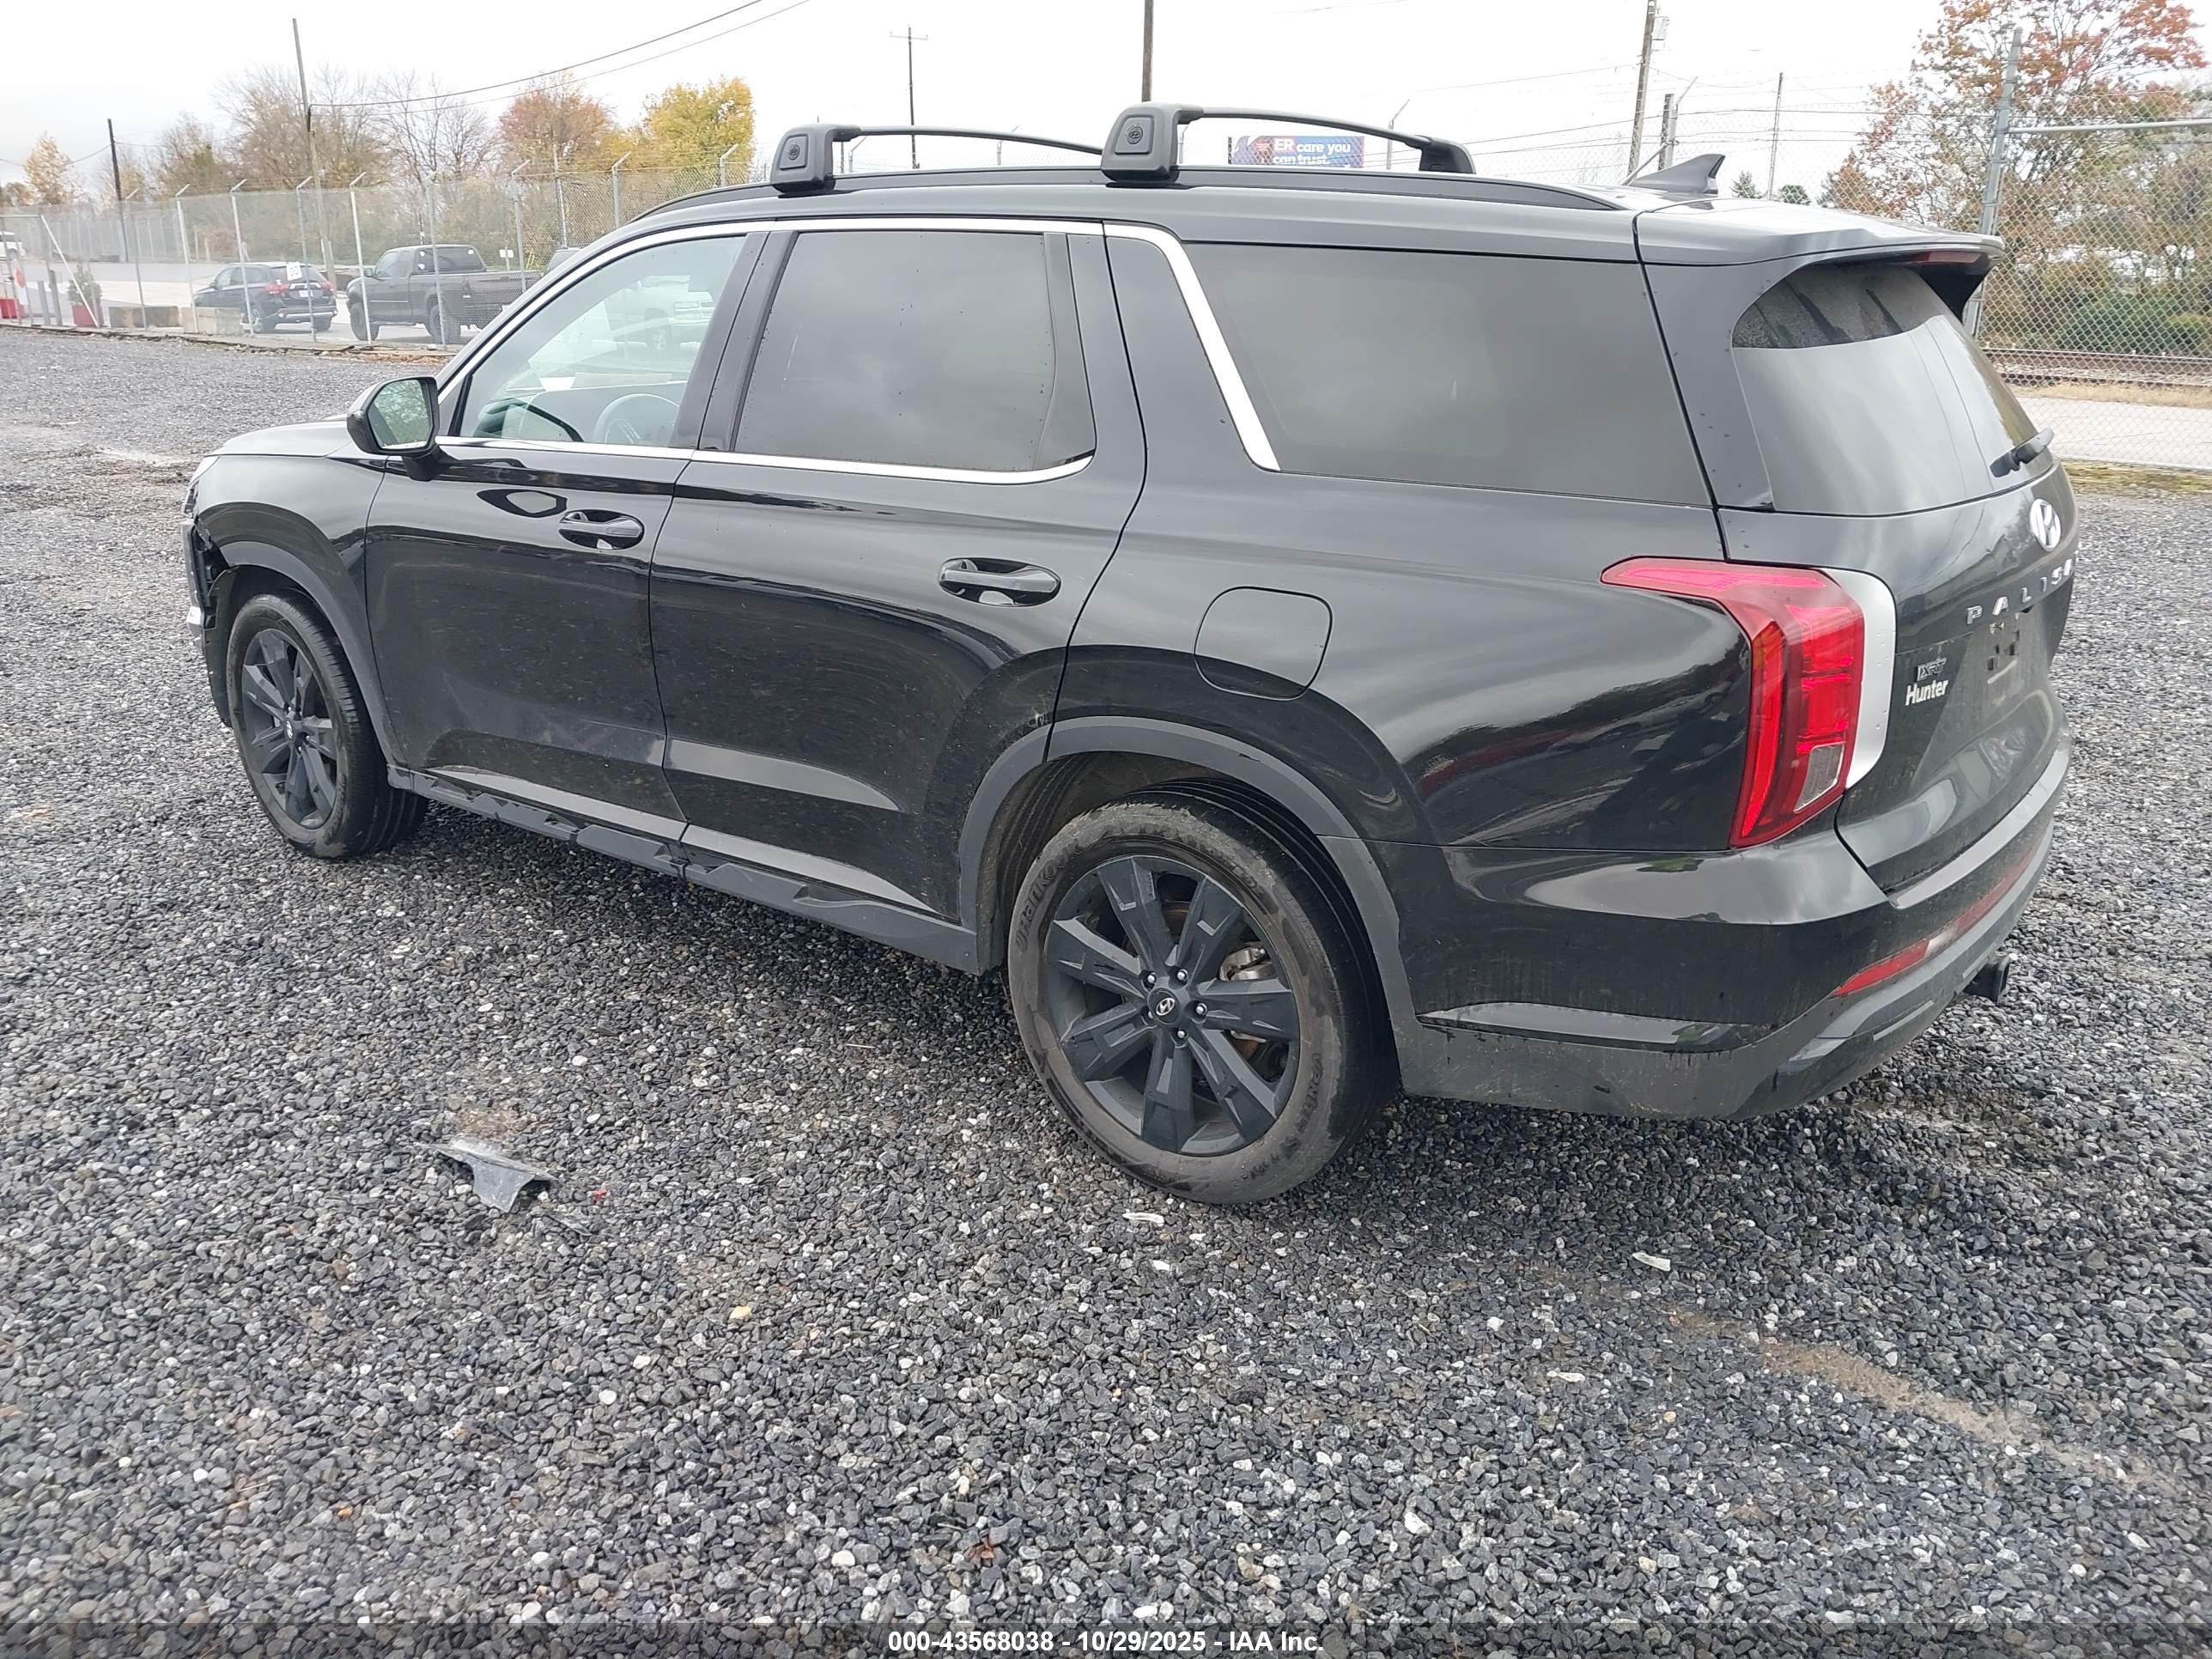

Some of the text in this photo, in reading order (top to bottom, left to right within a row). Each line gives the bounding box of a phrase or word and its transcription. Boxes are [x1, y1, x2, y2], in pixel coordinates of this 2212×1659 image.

[1274, 138, 1295, 151] ER
[1297, 143, 1324, 152] care
[1328, 143, 1351, 155] you
[1273, 155, 1295, 164] can
[1905, 679, 1948, 706] Hunter
